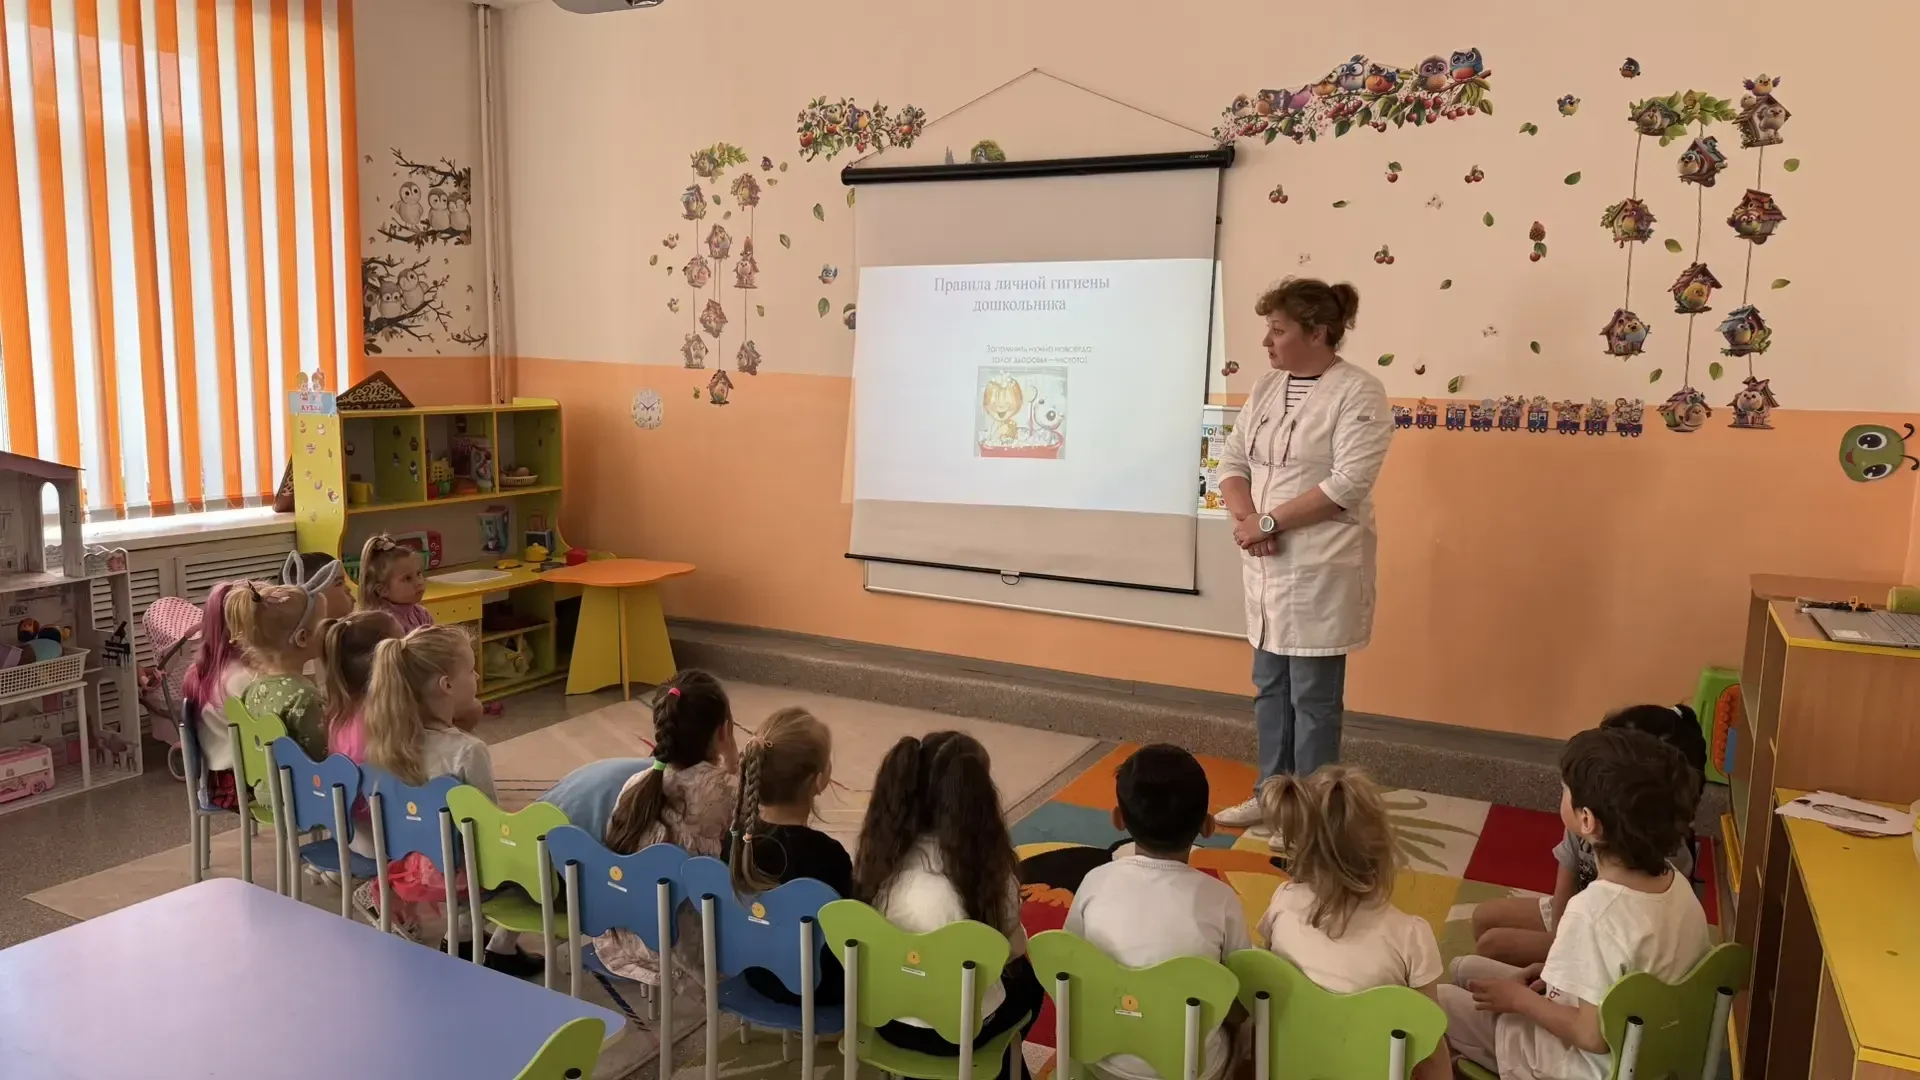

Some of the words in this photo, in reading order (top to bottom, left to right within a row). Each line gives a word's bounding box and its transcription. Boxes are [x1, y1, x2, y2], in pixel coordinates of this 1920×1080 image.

[934, 277, 991, 295] Правила
[995, 275, 1046, 291] личной
[1051, 276, 1110, 290] гигиены
[973, 299, 1066, 312] дошкольника
